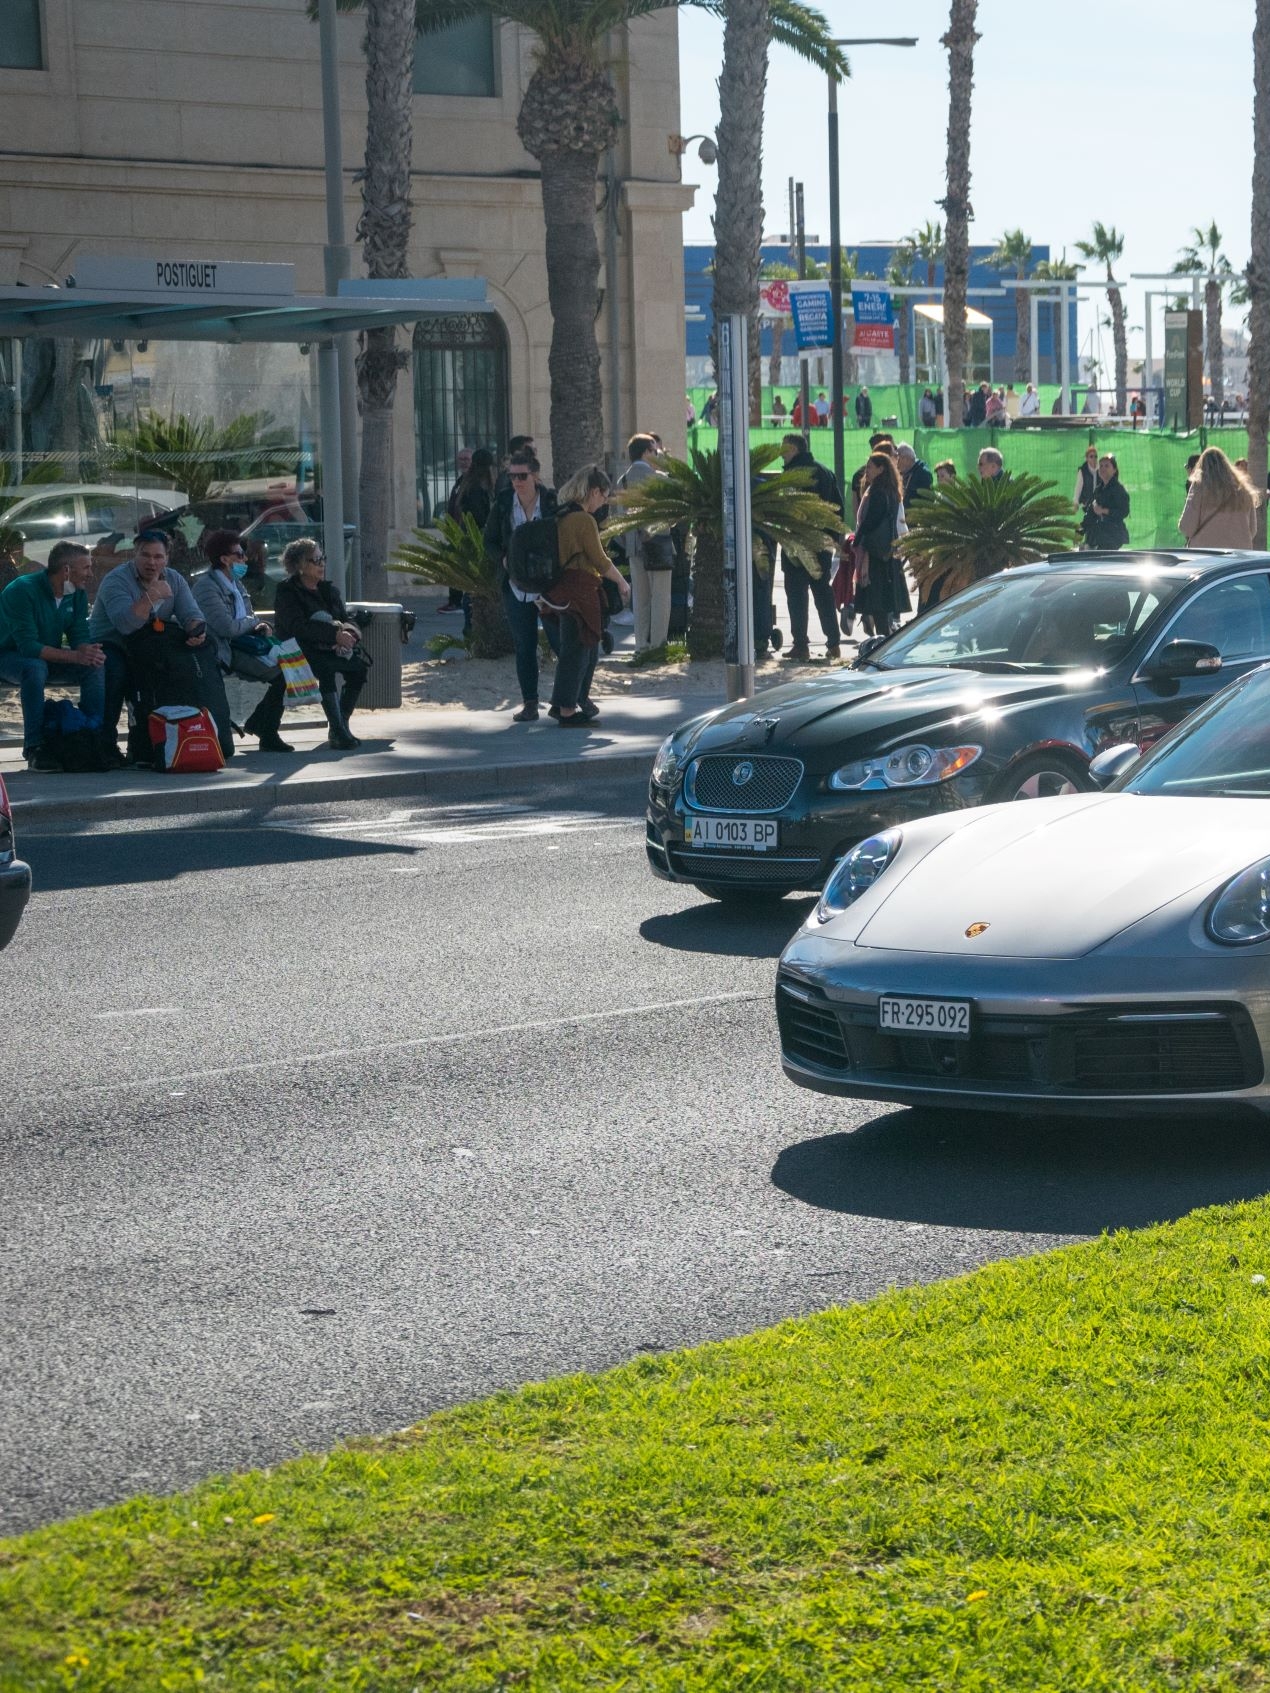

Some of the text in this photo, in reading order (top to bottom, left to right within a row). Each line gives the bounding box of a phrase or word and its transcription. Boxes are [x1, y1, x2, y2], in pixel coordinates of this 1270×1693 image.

[156, 262, 216, 288] POSTIGUET
[796, 299, 827, 309] GAMING
[799, 313, 827, 322] REGATA
[1165, 378, 1186, 388] WORLD
[1169, 388, 1181, 398] CUP
[715, 822, 748, 841] 0103
[754, 824, 775, 842] BP
